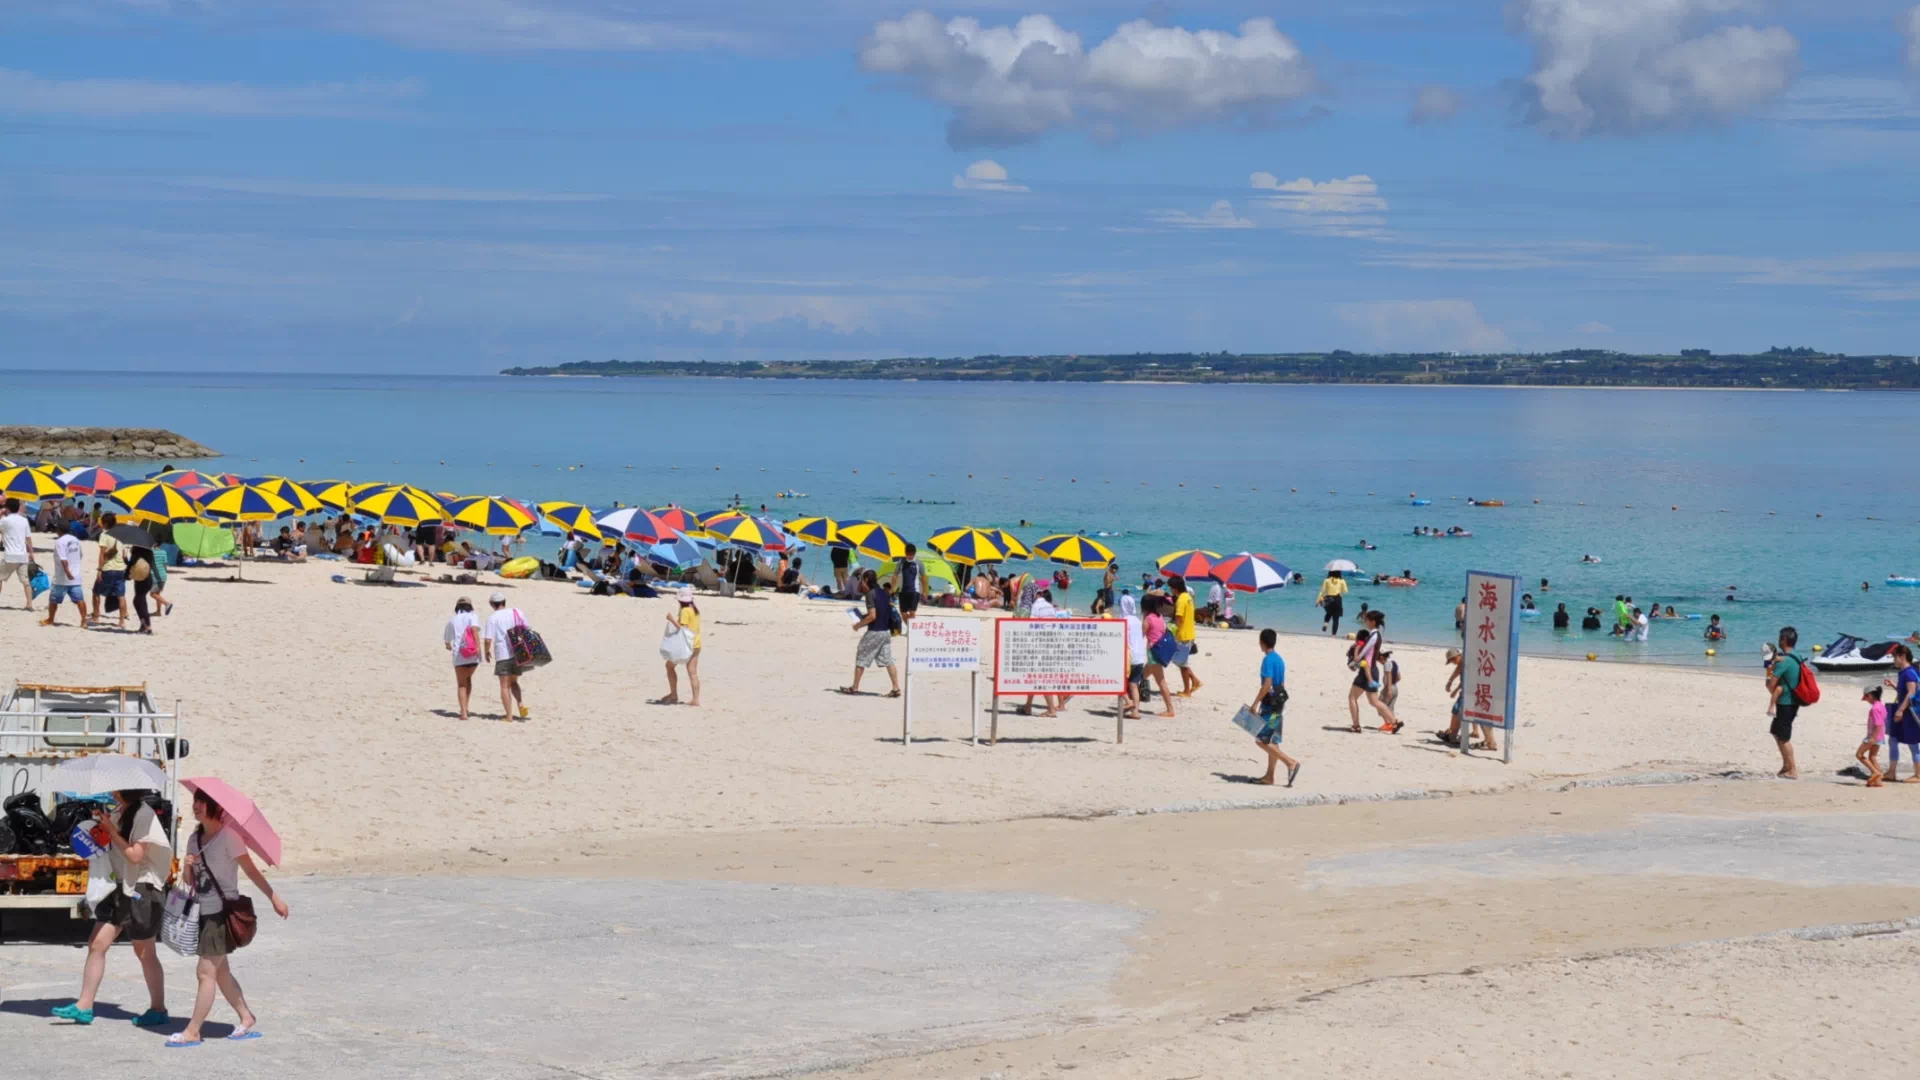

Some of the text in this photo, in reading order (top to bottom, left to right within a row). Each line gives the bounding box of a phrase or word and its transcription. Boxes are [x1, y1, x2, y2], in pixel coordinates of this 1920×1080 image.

[911, 621, 944, 629] およげるよ
[924, 629, 971, 637] ゆだんみせたら
[944, 637, 977, 646] うみのそこ
[1474, 581, 1499, 712] 海水浴場
